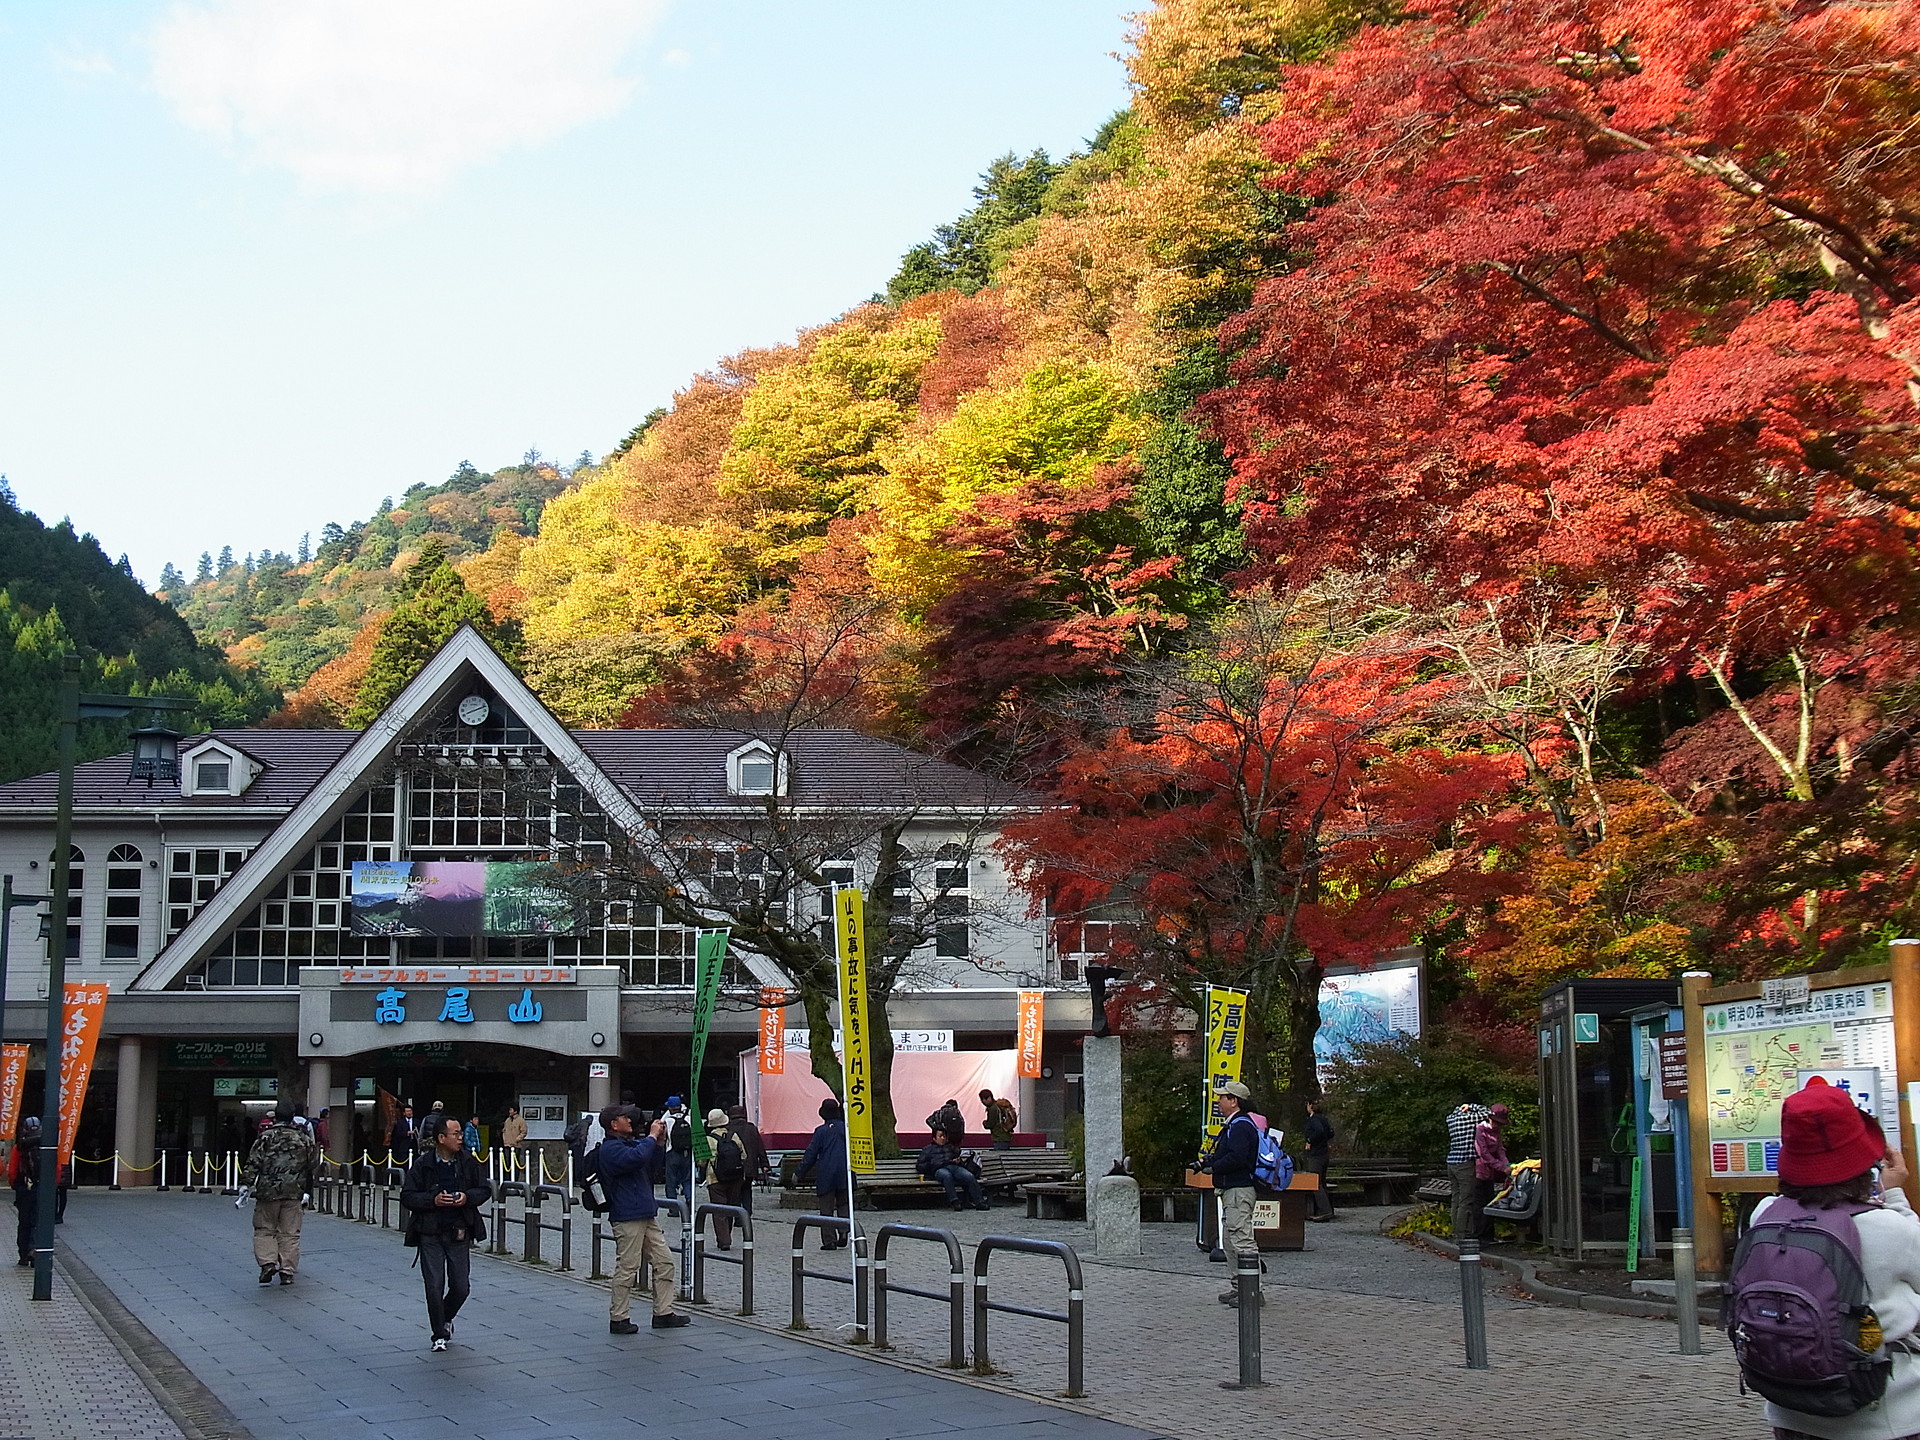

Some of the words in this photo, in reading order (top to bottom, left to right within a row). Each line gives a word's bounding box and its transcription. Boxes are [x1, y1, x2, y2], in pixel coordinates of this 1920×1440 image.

[341, 969, 447, 982] ケーブルカー
[466, 969, 571, 982] エコーリフト
[844, 897, 865, 1116] 山の事故に気をつけよう
[1727, 1004, 1765, 1023] 明治の森
[175, 1042, 267, 1053] ケーブルカーのりば
